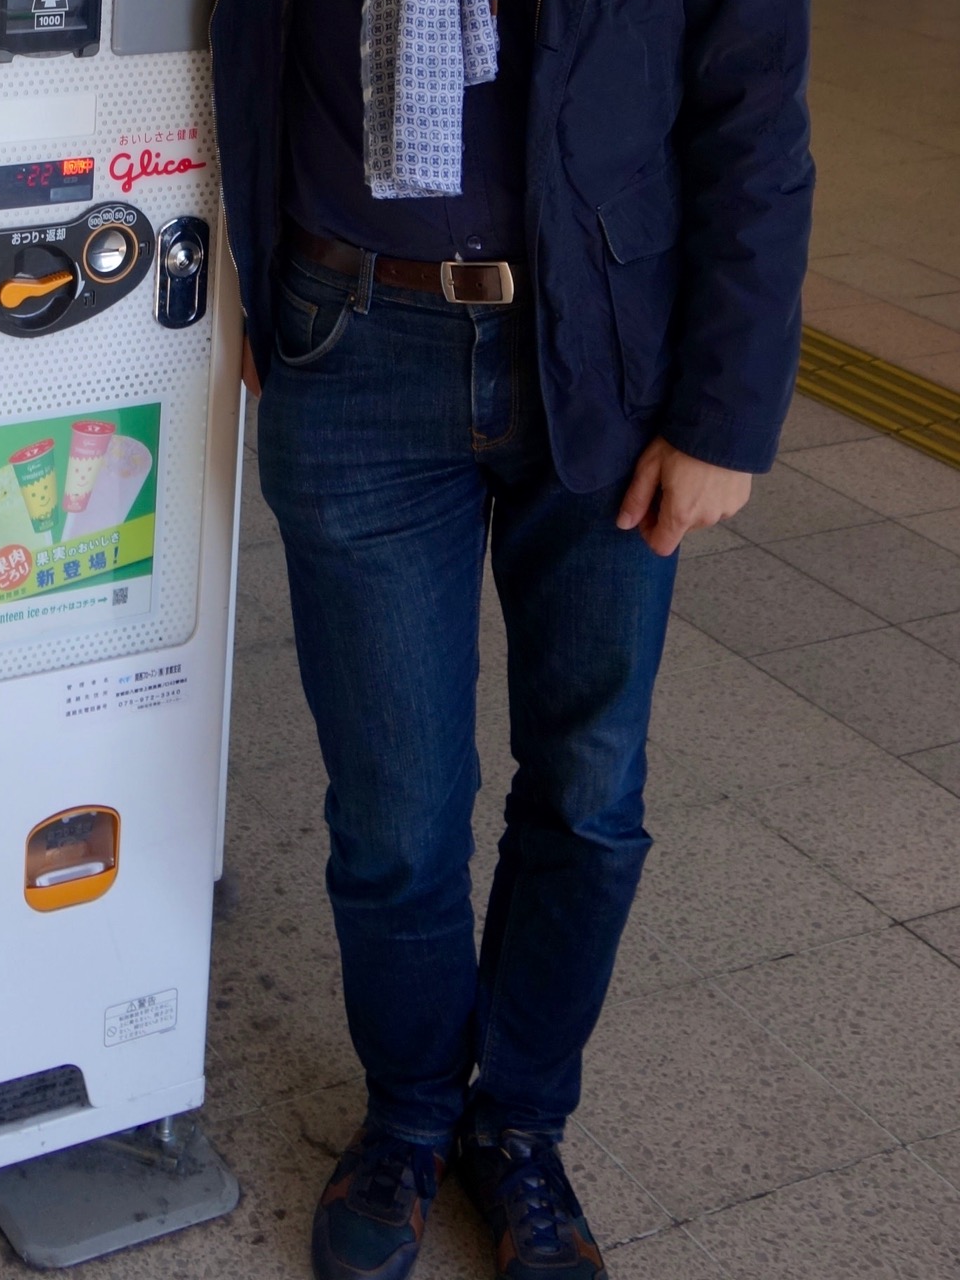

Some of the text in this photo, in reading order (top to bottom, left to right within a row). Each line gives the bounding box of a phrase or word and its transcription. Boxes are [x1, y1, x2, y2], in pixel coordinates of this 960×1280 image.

[39, 14, 60, 26] 1000
[119, 128, 198, 147] おいしさと健康
[109, 149, 206, 194] Glico
[11, 228, 67, 245] おつり・返却
[35, 530, 121, 568] 果実のおいしさ
[35, 545, 119, 588] 新登場!
[27, 605, 40, 618] ice
[41, 597, 96, 616] のサイトはコチラ
